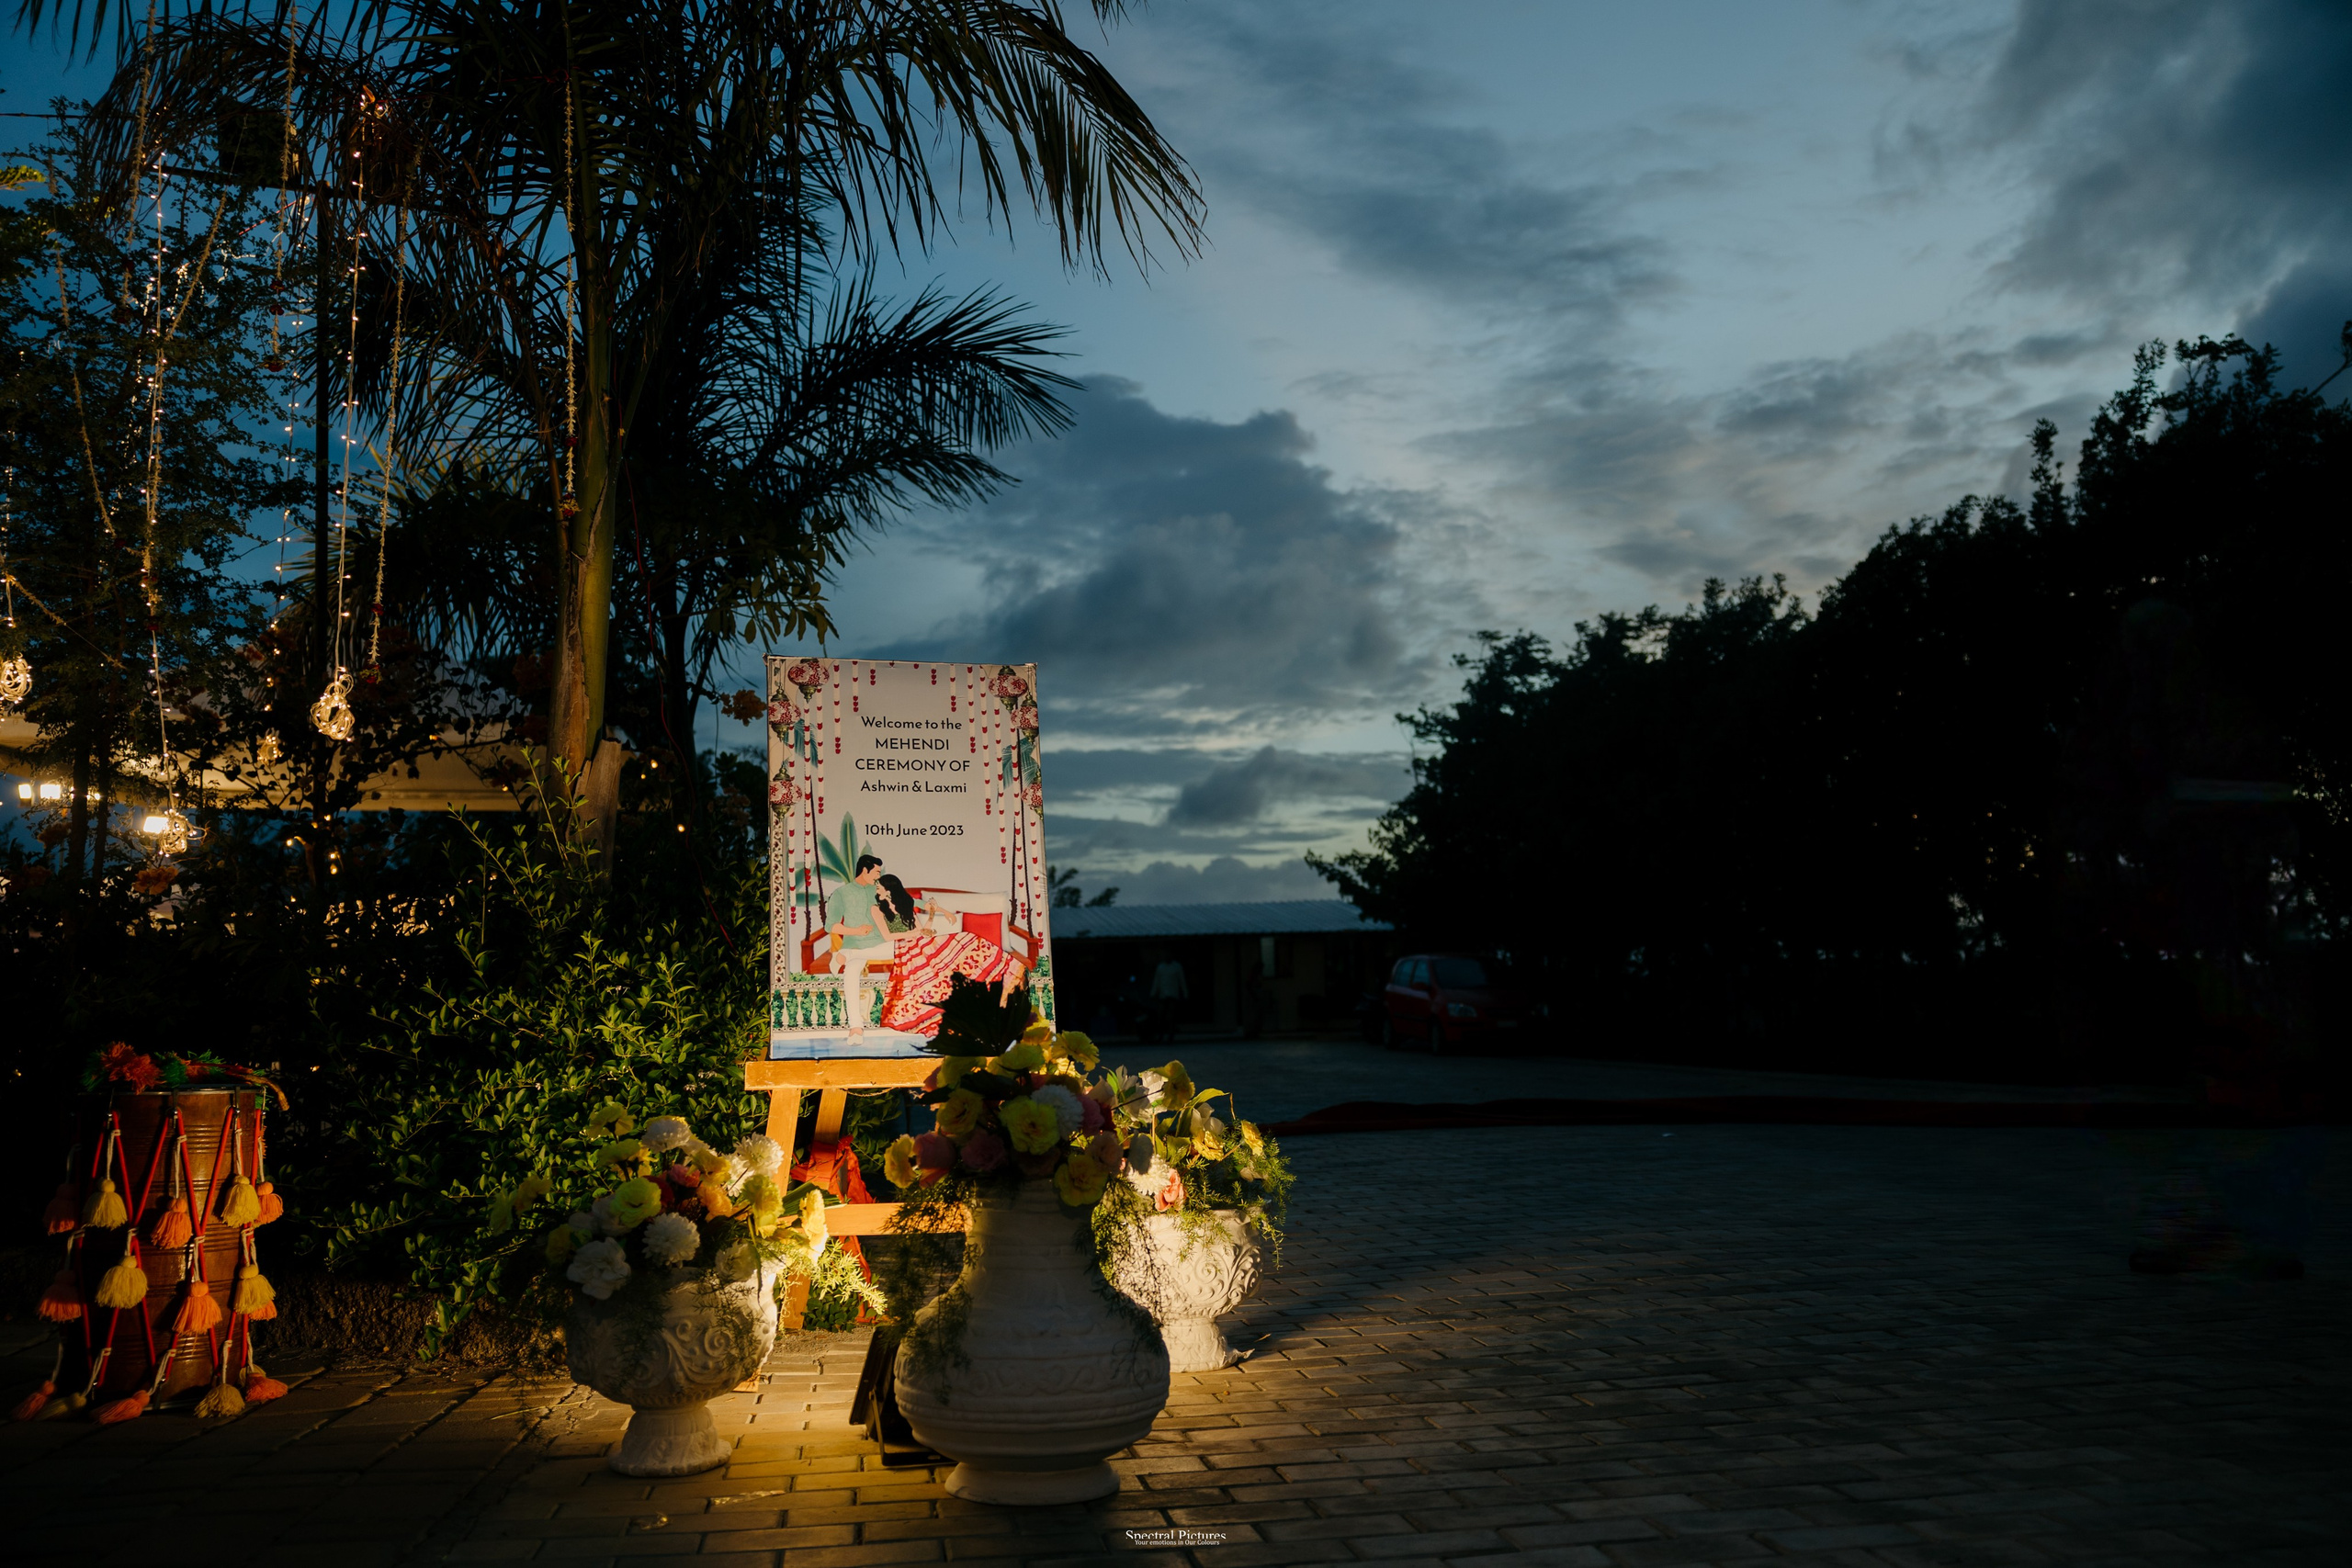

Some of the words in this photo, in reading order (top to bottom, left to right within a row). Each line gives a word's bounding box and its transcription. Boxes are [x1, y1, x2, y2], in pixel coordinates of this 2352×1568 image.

[860, 716, 923, 729] Welcome
[924, 719, 939, 729] to
[940, 717, 963, 730] the
[875, 738, 949, 750] MEHENDI
[854, 758, 947, 772] CEREMONY
[949, 760, 971, 773] OF
[860, 779, 909, 793] Ashwin
[911, 780, 922, 793] &
[925, 781, 967, 793] Laxmi
[865, 822, 894, 836] 10th
[896, 823, 928, 838] June
[929, 824, 964, 836] 2023
